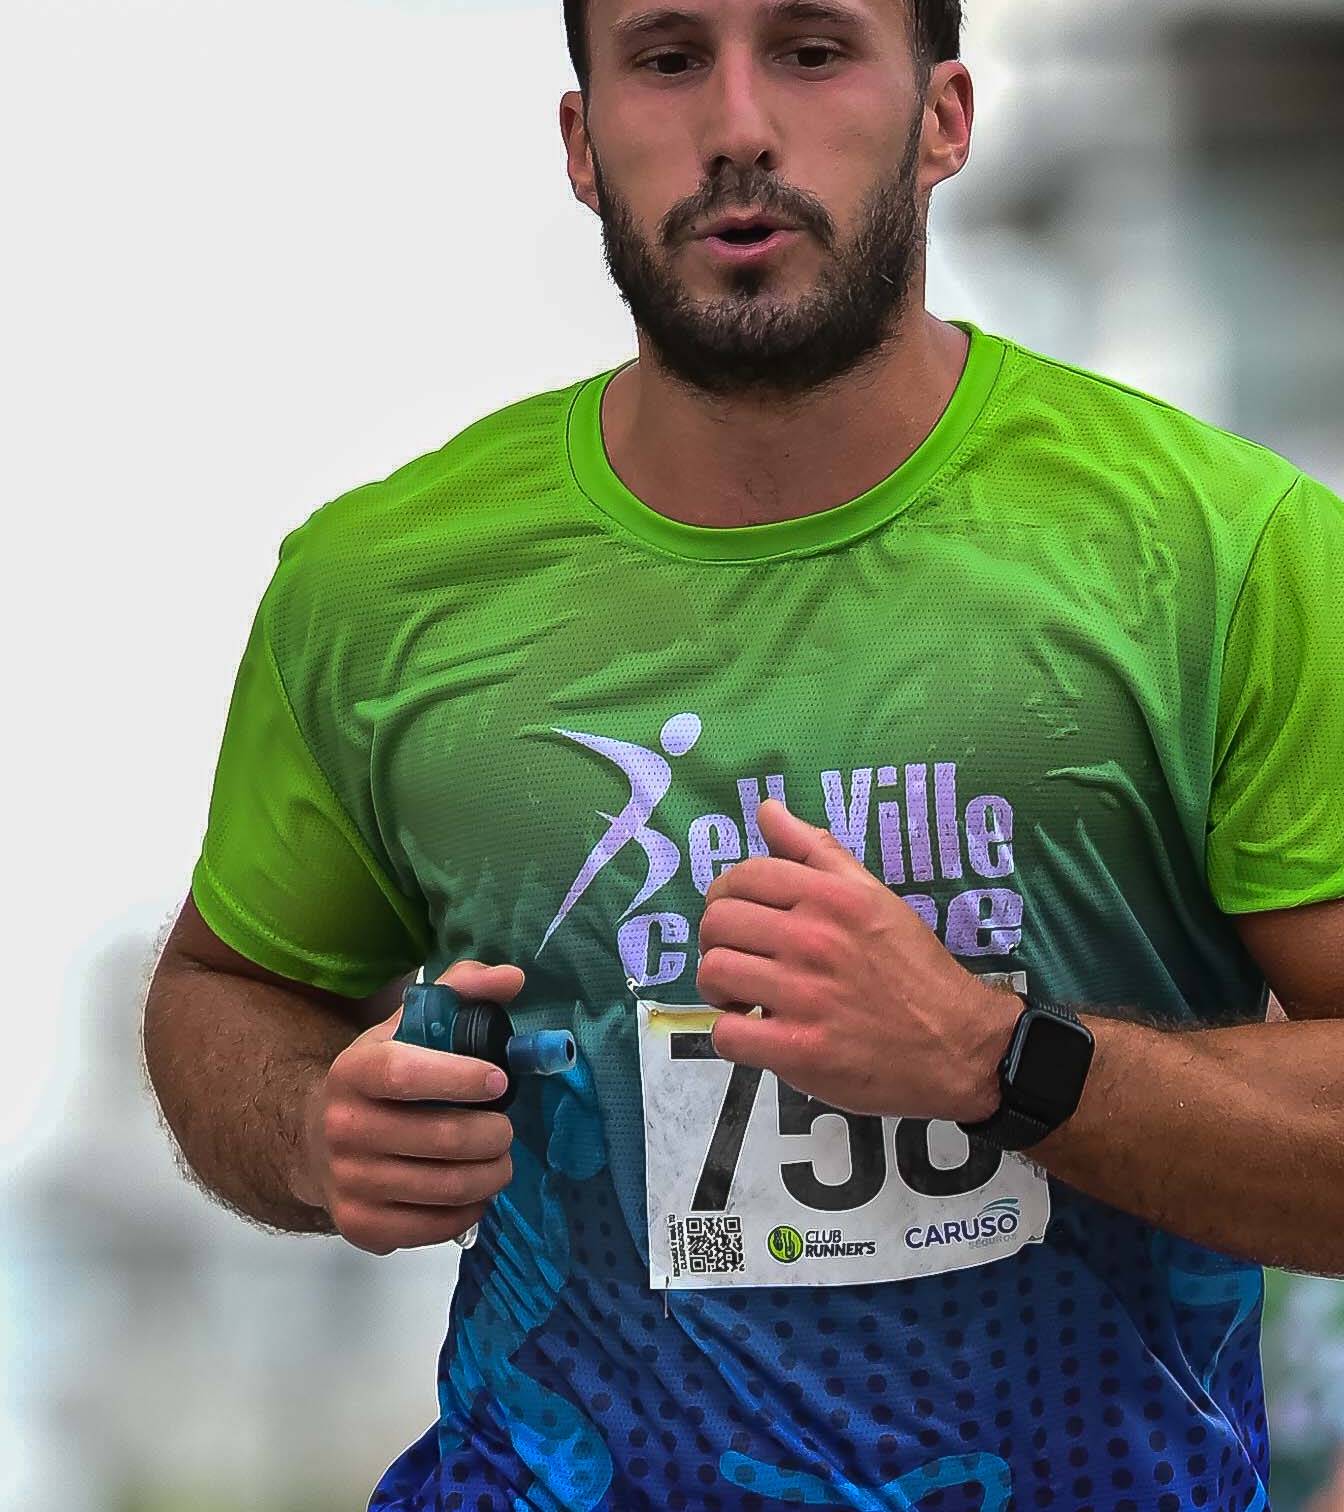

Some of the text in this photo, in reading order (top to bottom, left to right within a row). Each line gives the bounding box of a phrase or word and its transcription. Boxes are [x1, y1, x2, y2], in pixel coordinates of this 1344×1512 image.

[821, 762, 1014, 885] Ville
[805, 1229, 842, 1244] CLUB
[905, 1213, 1018, 1249] CARUSO
[805, 1242, 876, 1257] RUNNER'S
